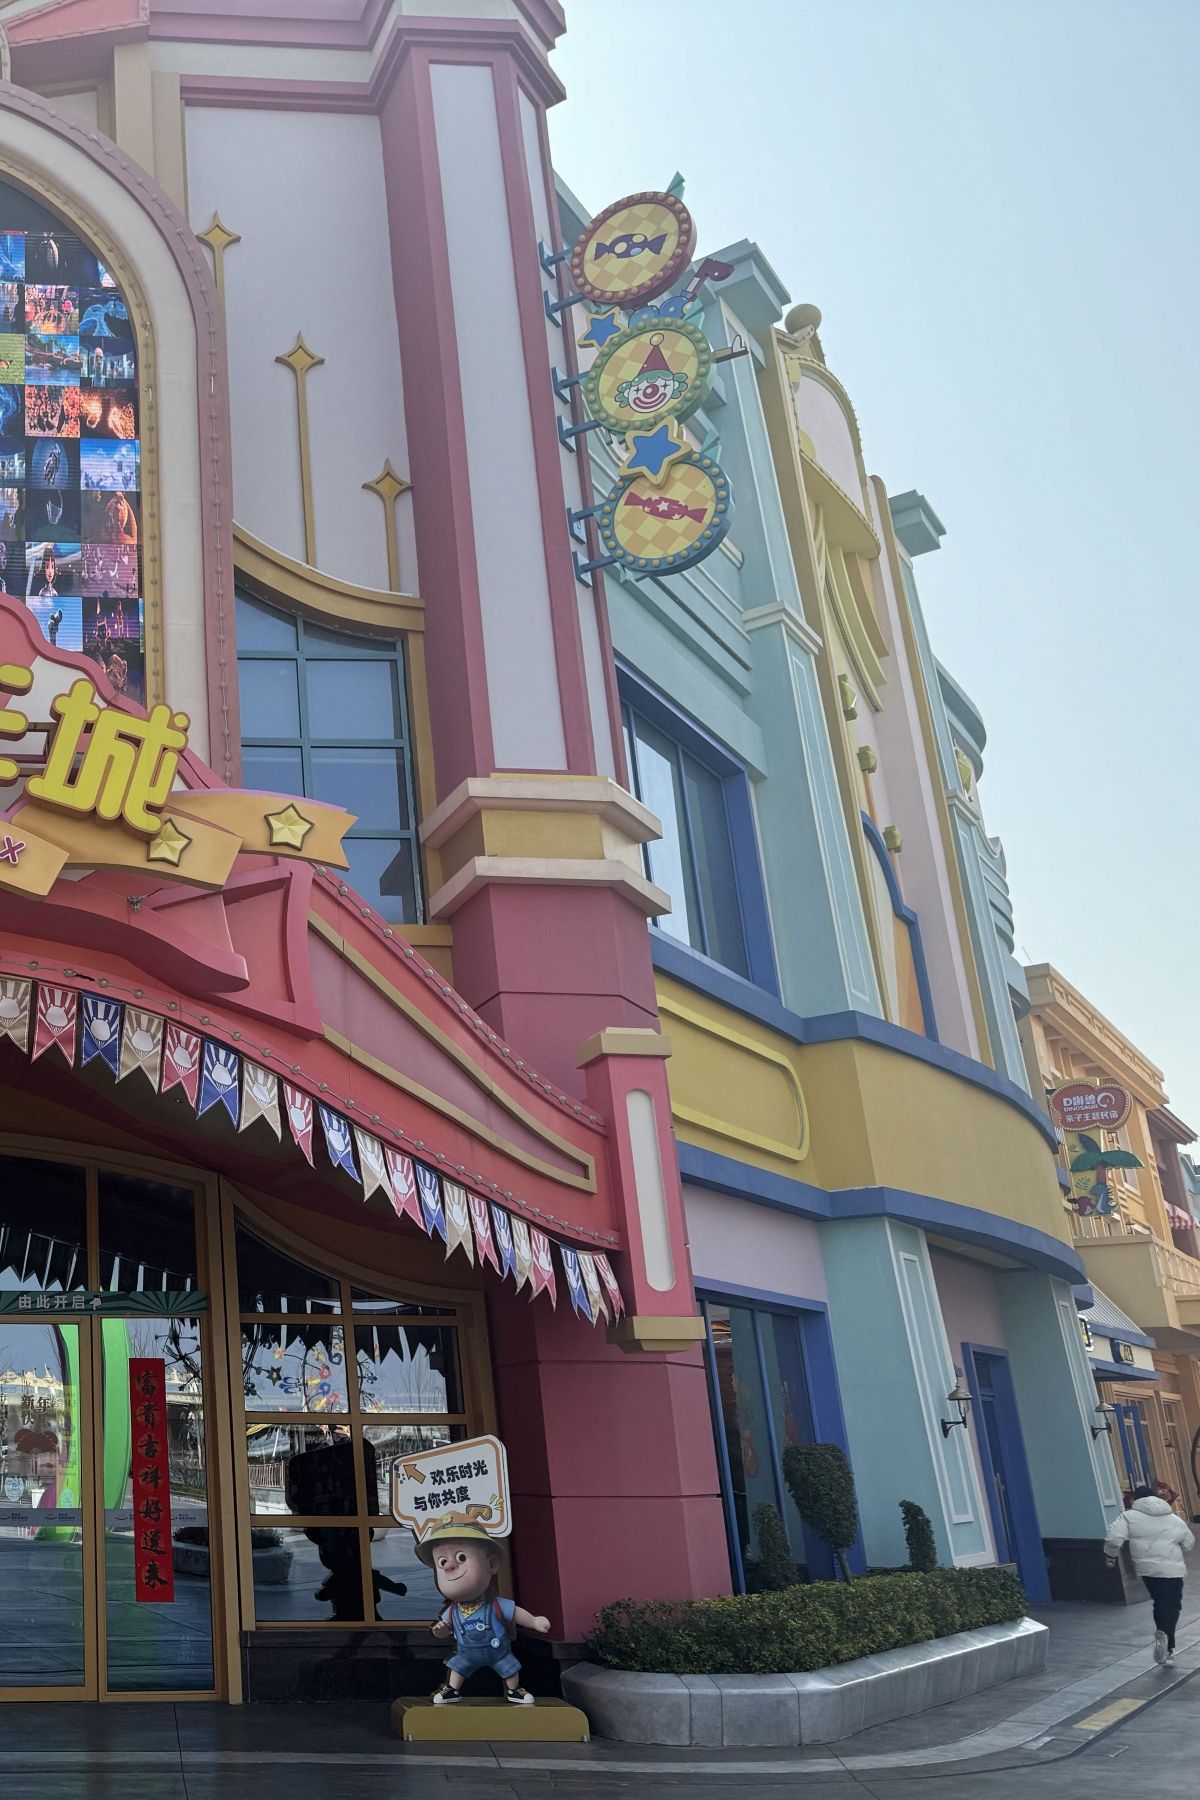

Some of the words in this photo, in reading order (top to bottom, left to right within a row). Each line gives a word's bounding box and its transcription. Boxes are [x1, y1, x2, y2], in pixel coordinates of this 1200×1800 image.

[18, 1294, 86, 1309] 由此开启
[429, 1459, 489, 1486] 欢乐时光
[413, 1485, 471, 1512] 与你共度
